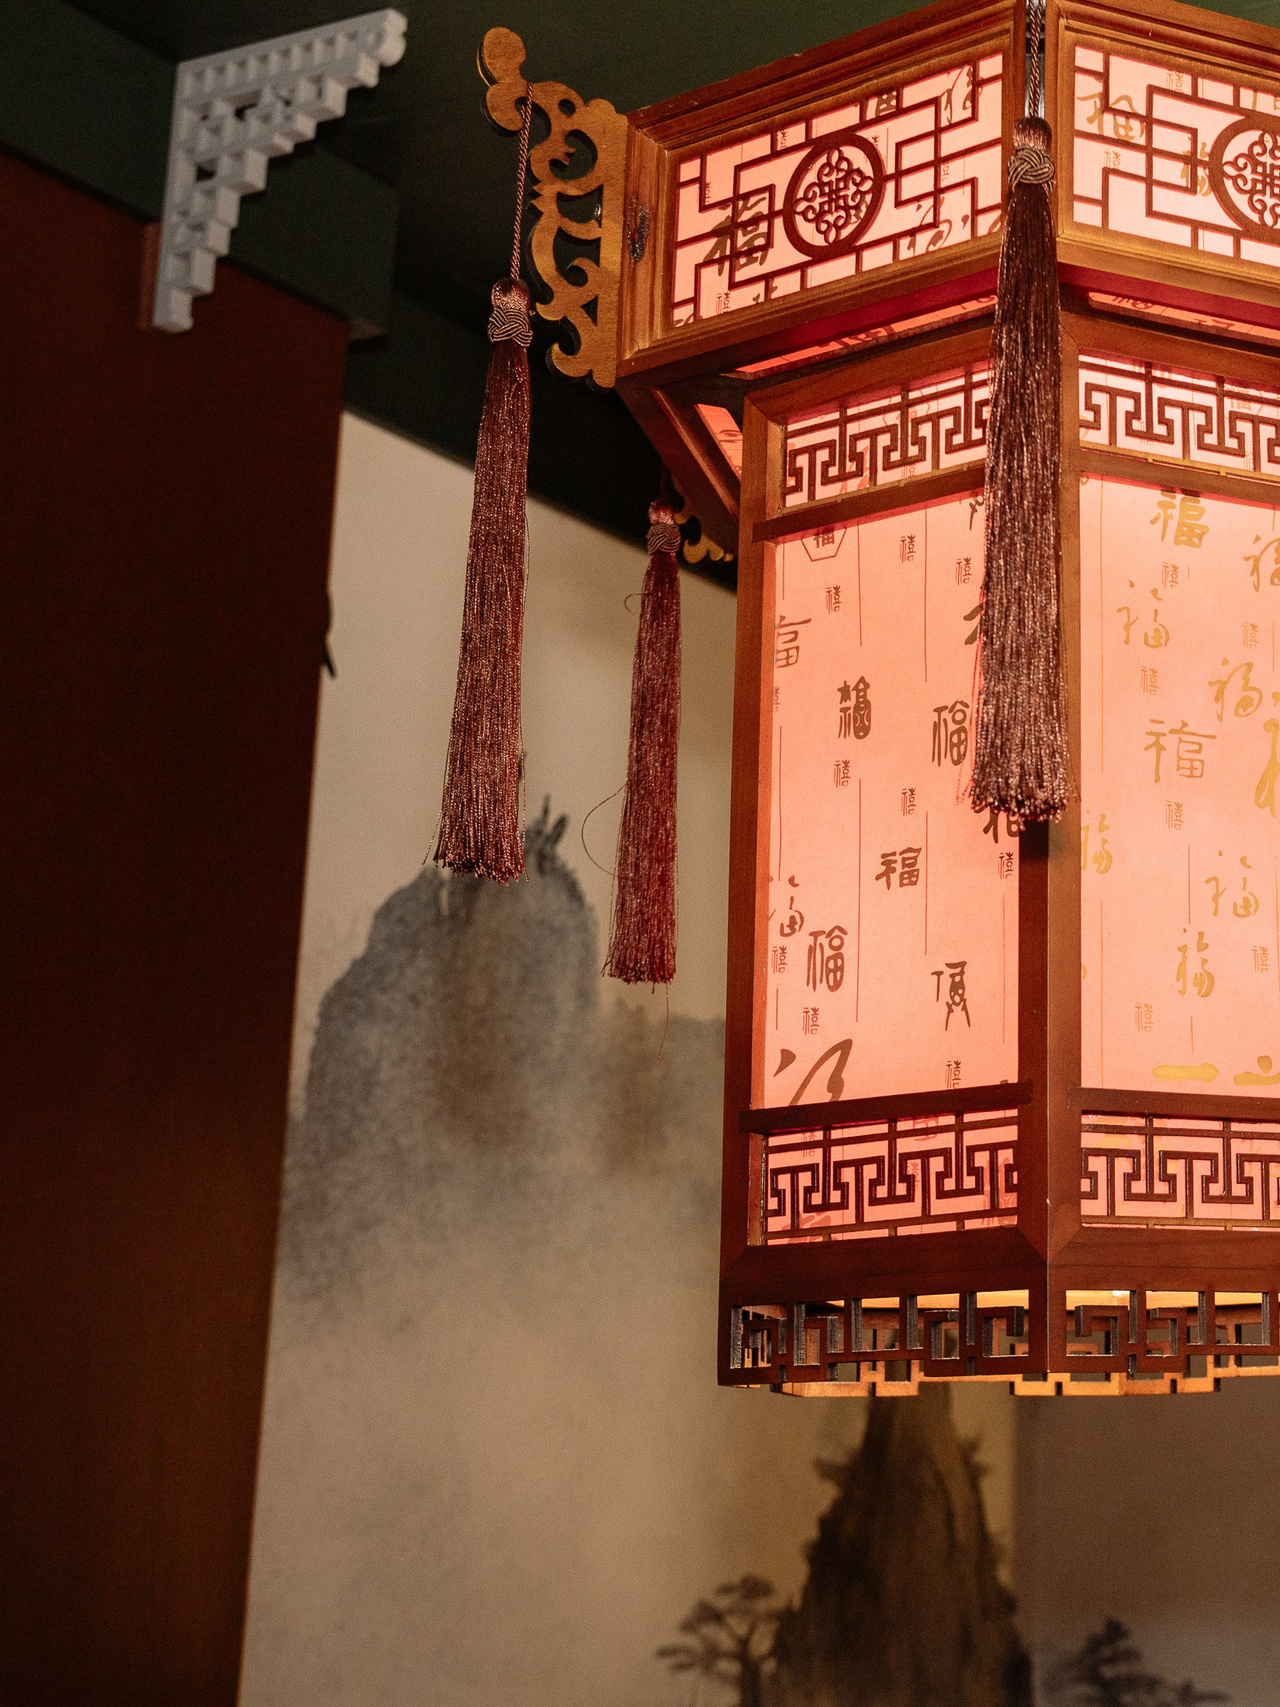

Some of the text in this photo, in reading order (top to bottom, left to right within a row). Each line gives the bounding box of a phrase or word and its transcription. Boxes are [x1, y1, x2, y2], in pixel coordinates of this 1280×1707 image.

[932, 700, 970, 767] 福
[1144, 718, 1217, 784] 福
[875, 847, 923, 891] 福
[806, 925, 848, 992] 福
